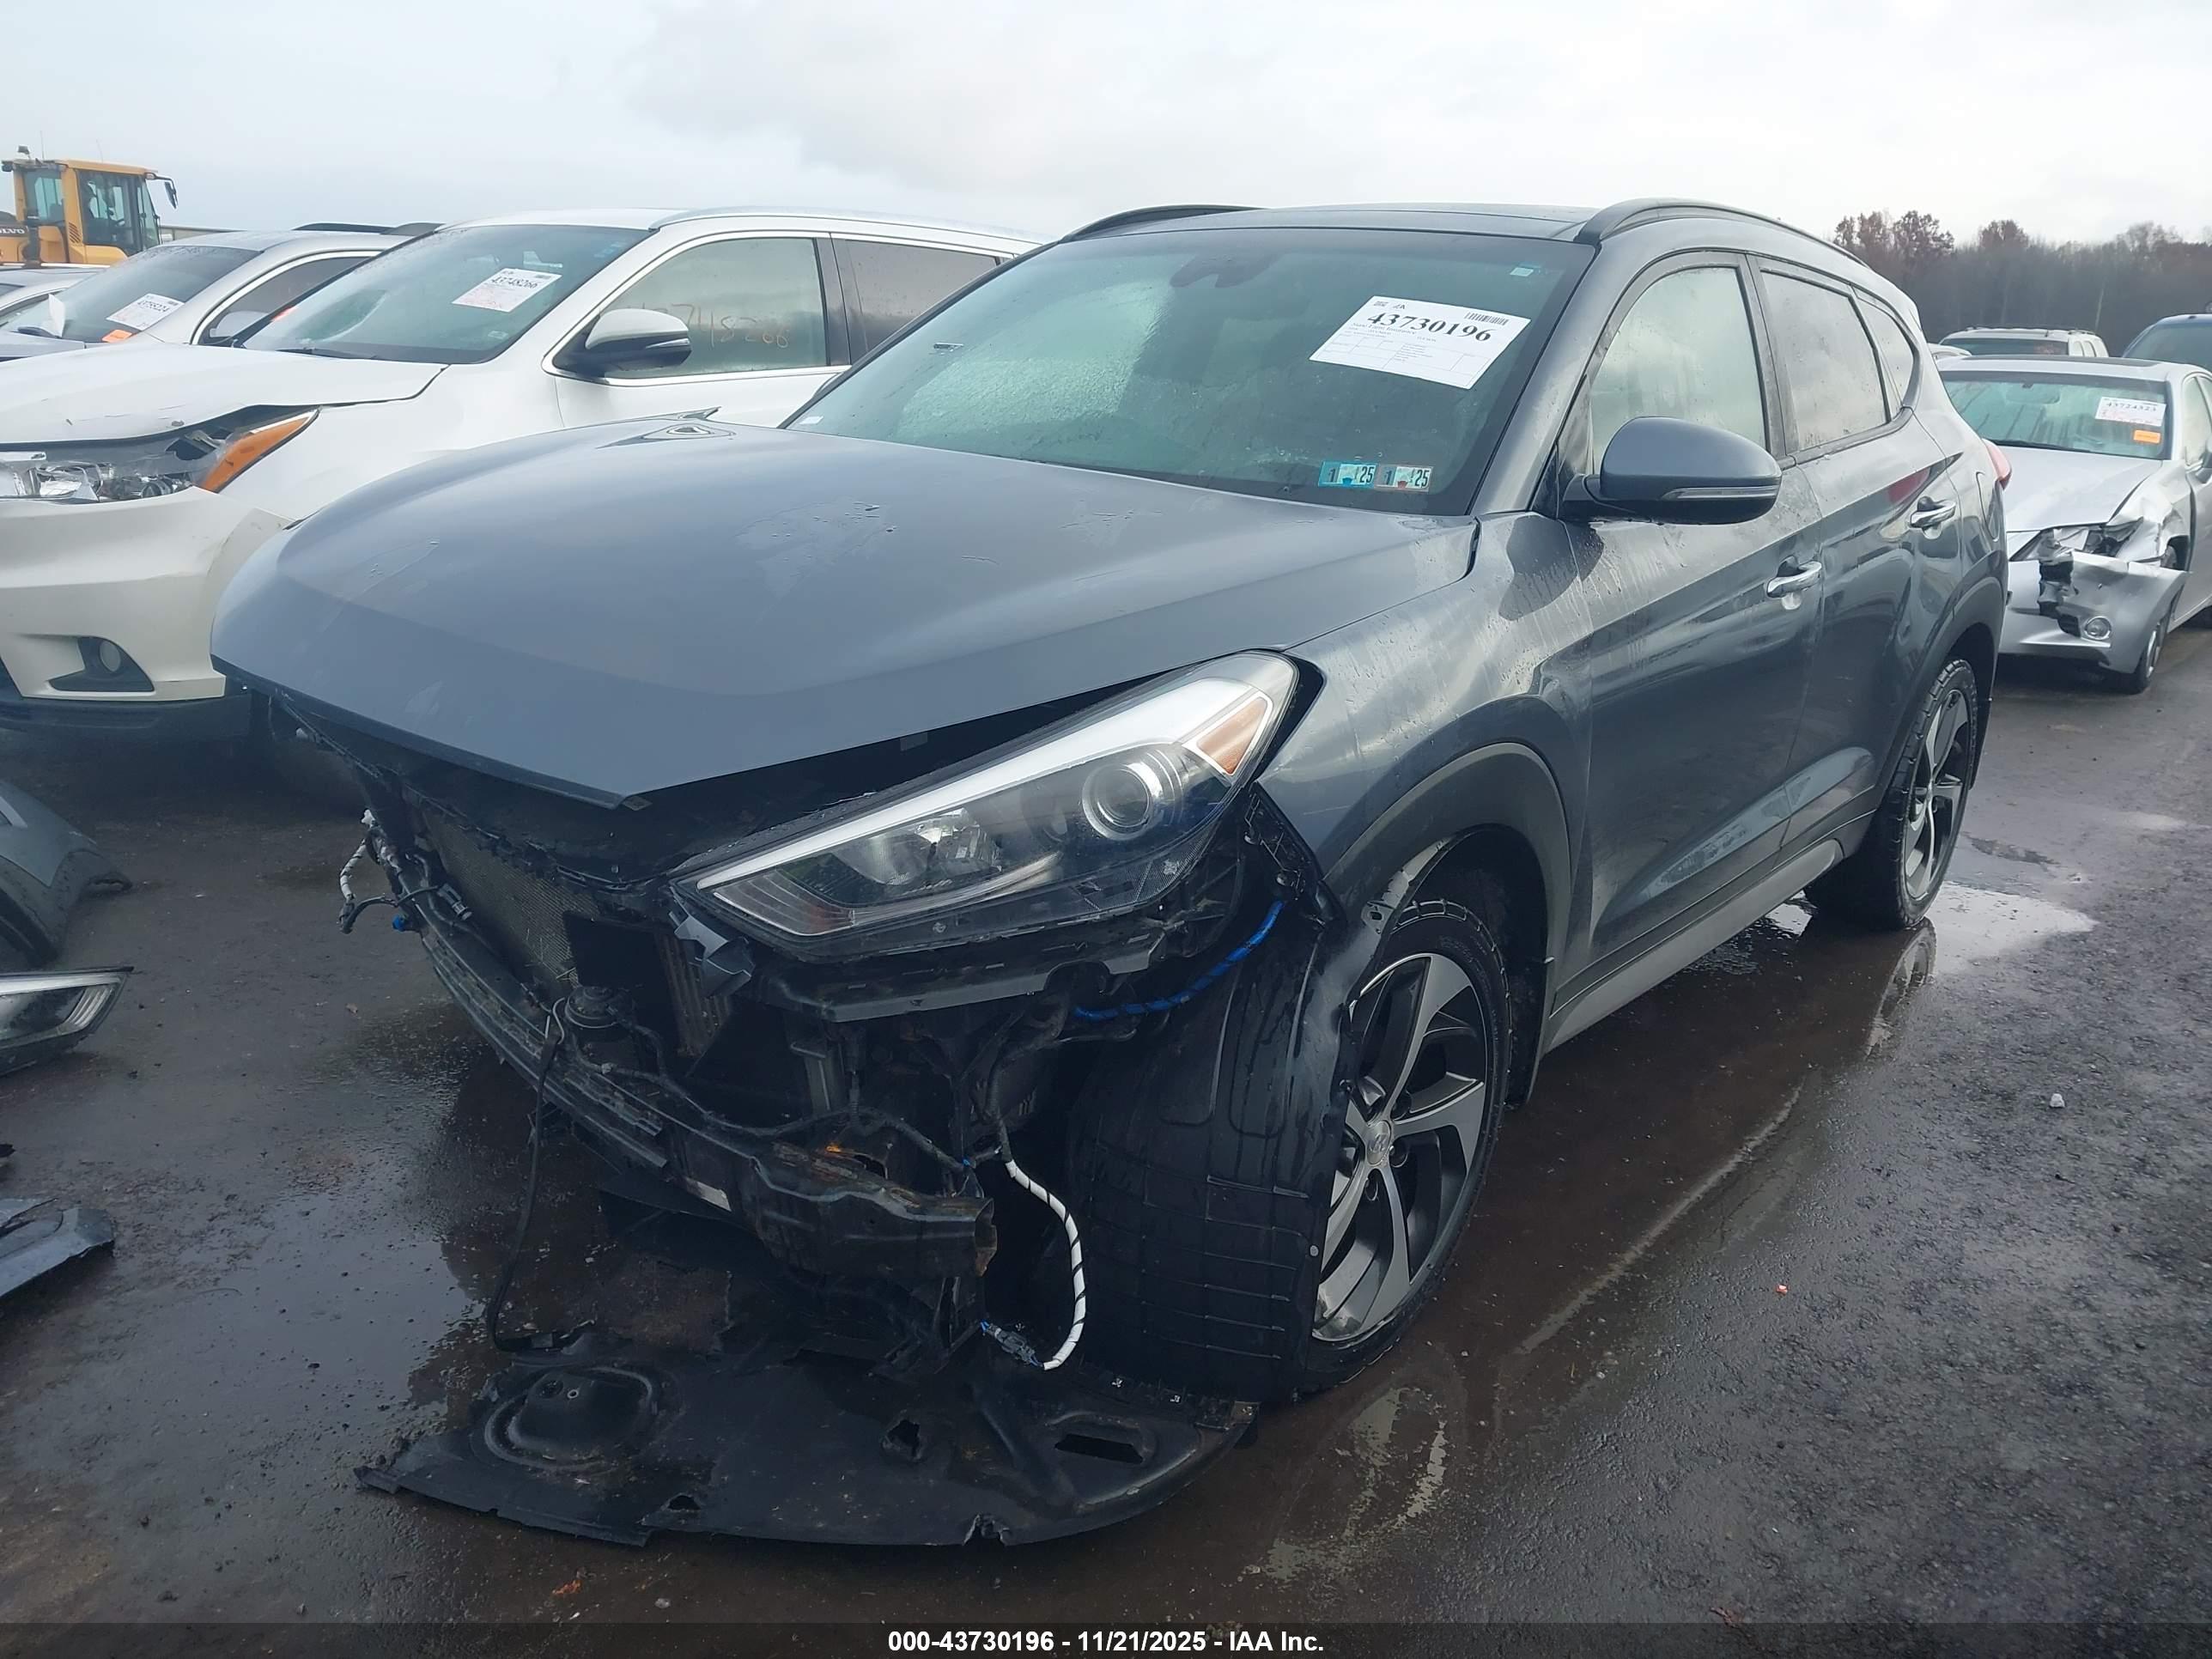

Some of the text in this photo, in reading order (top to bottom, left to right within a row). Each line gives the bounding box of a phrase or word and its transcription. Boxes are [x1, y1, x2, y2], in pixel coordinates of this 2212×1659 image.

[1367, 312, 1497, 342] 43730196
[1328, 466, 1375, 483] 1 25
[1385, 469, 1430, 487] 1 25
